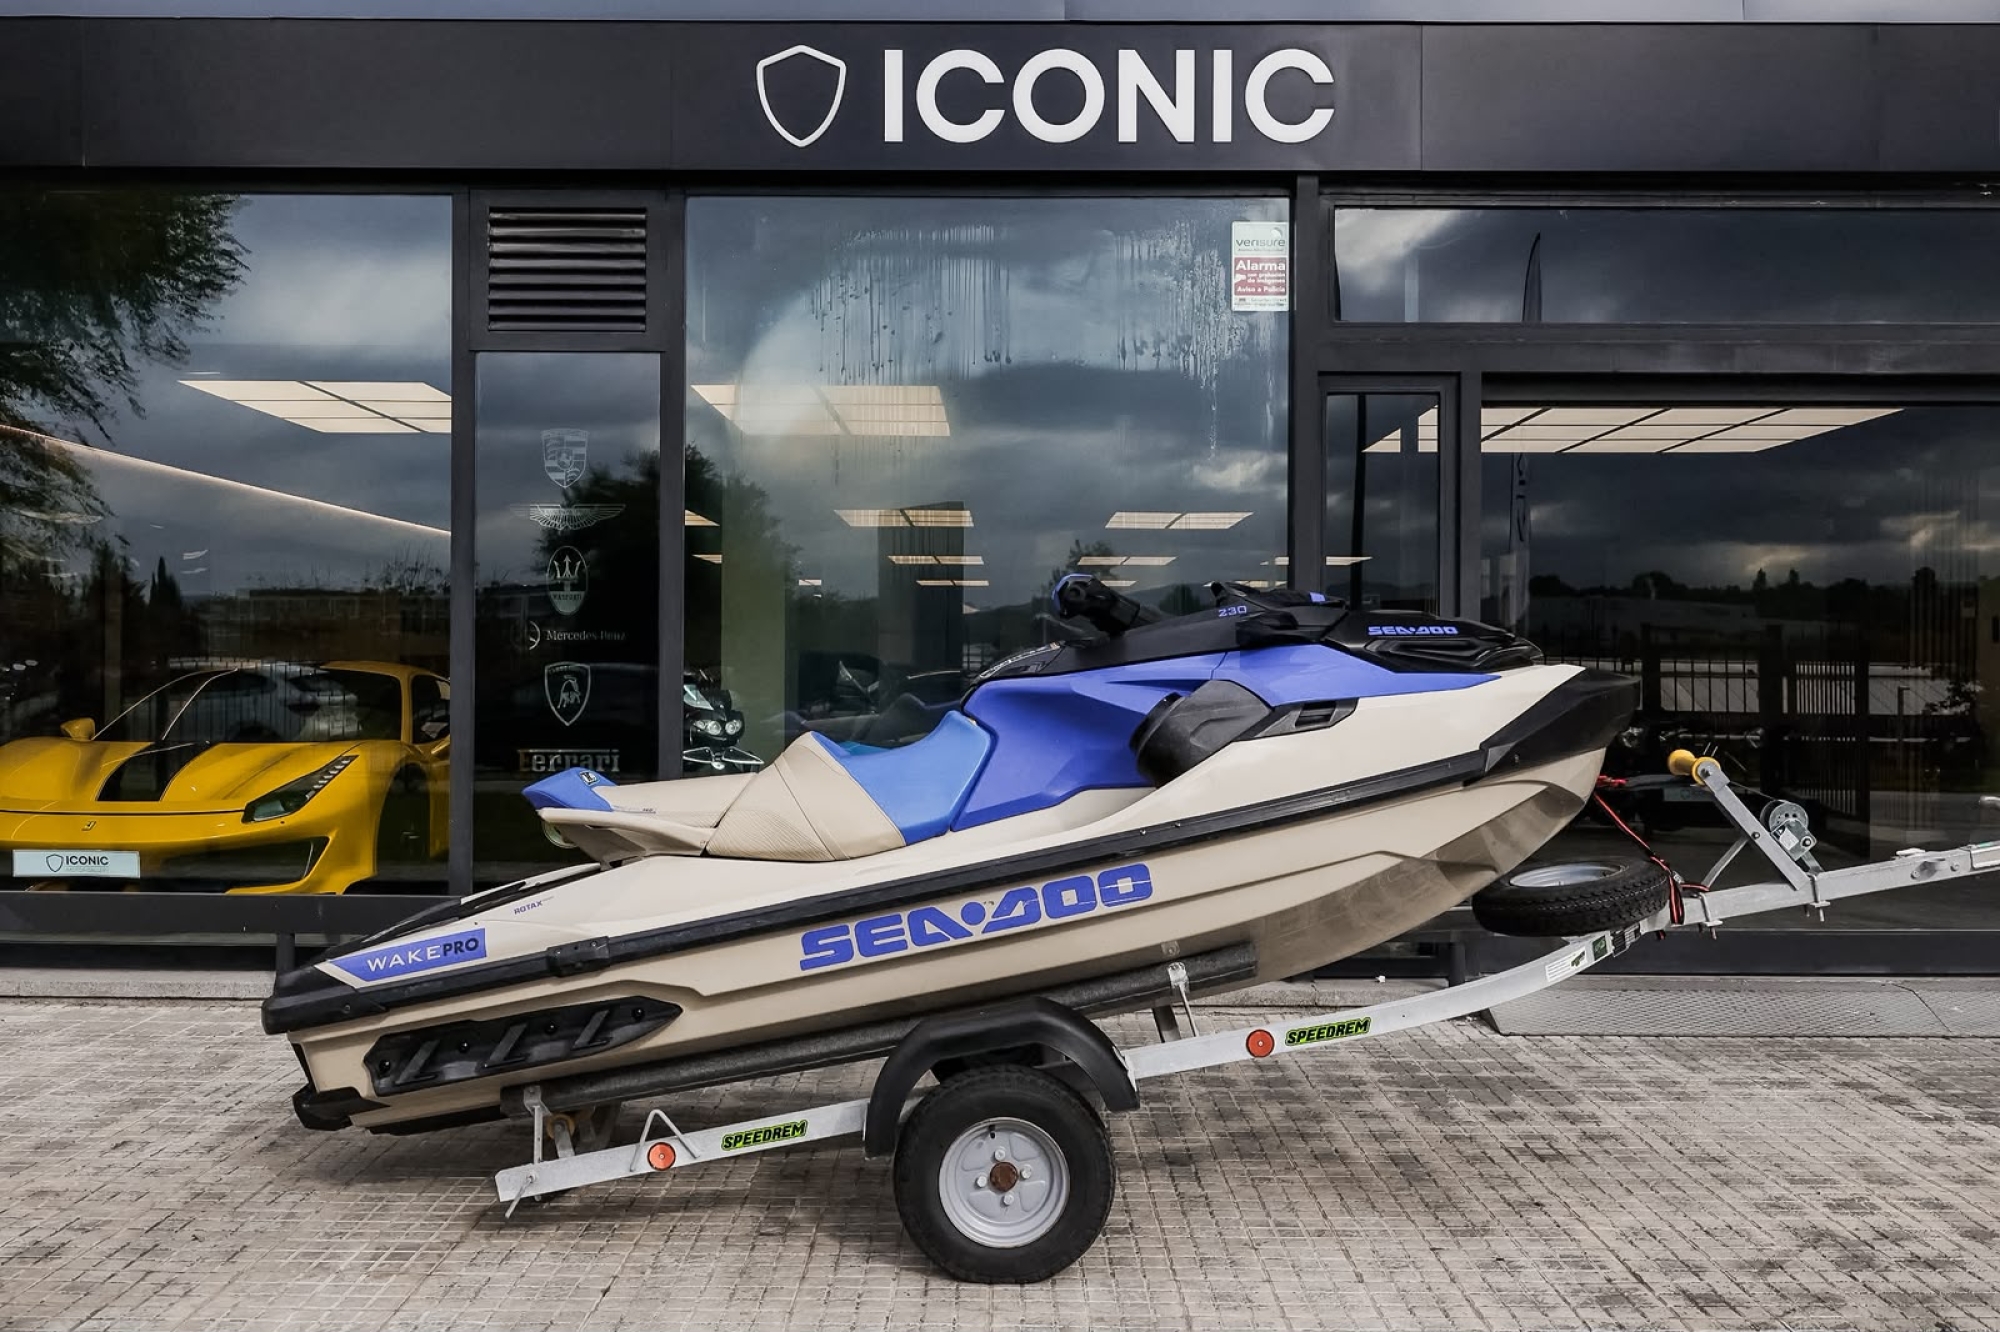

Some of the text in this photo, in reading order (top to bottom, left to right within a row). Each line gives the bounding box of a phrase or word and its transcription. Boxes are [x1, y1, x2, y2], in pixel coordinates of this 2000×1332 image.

[884, 48, 1334, 143] ICONIC
[1236, 260, 1286, 271] Alarma
[1218, 605, 1248, 617] 230
[517, 749, 620, 772] Ferrari
[66, 855, 109, 866] ICONIC
[514, 900, 543, 915] ROTAX
[1287, 1019, 1370, 1044] SPEEDREM
[723, 1121, 807, 1149] SPEEDREM
